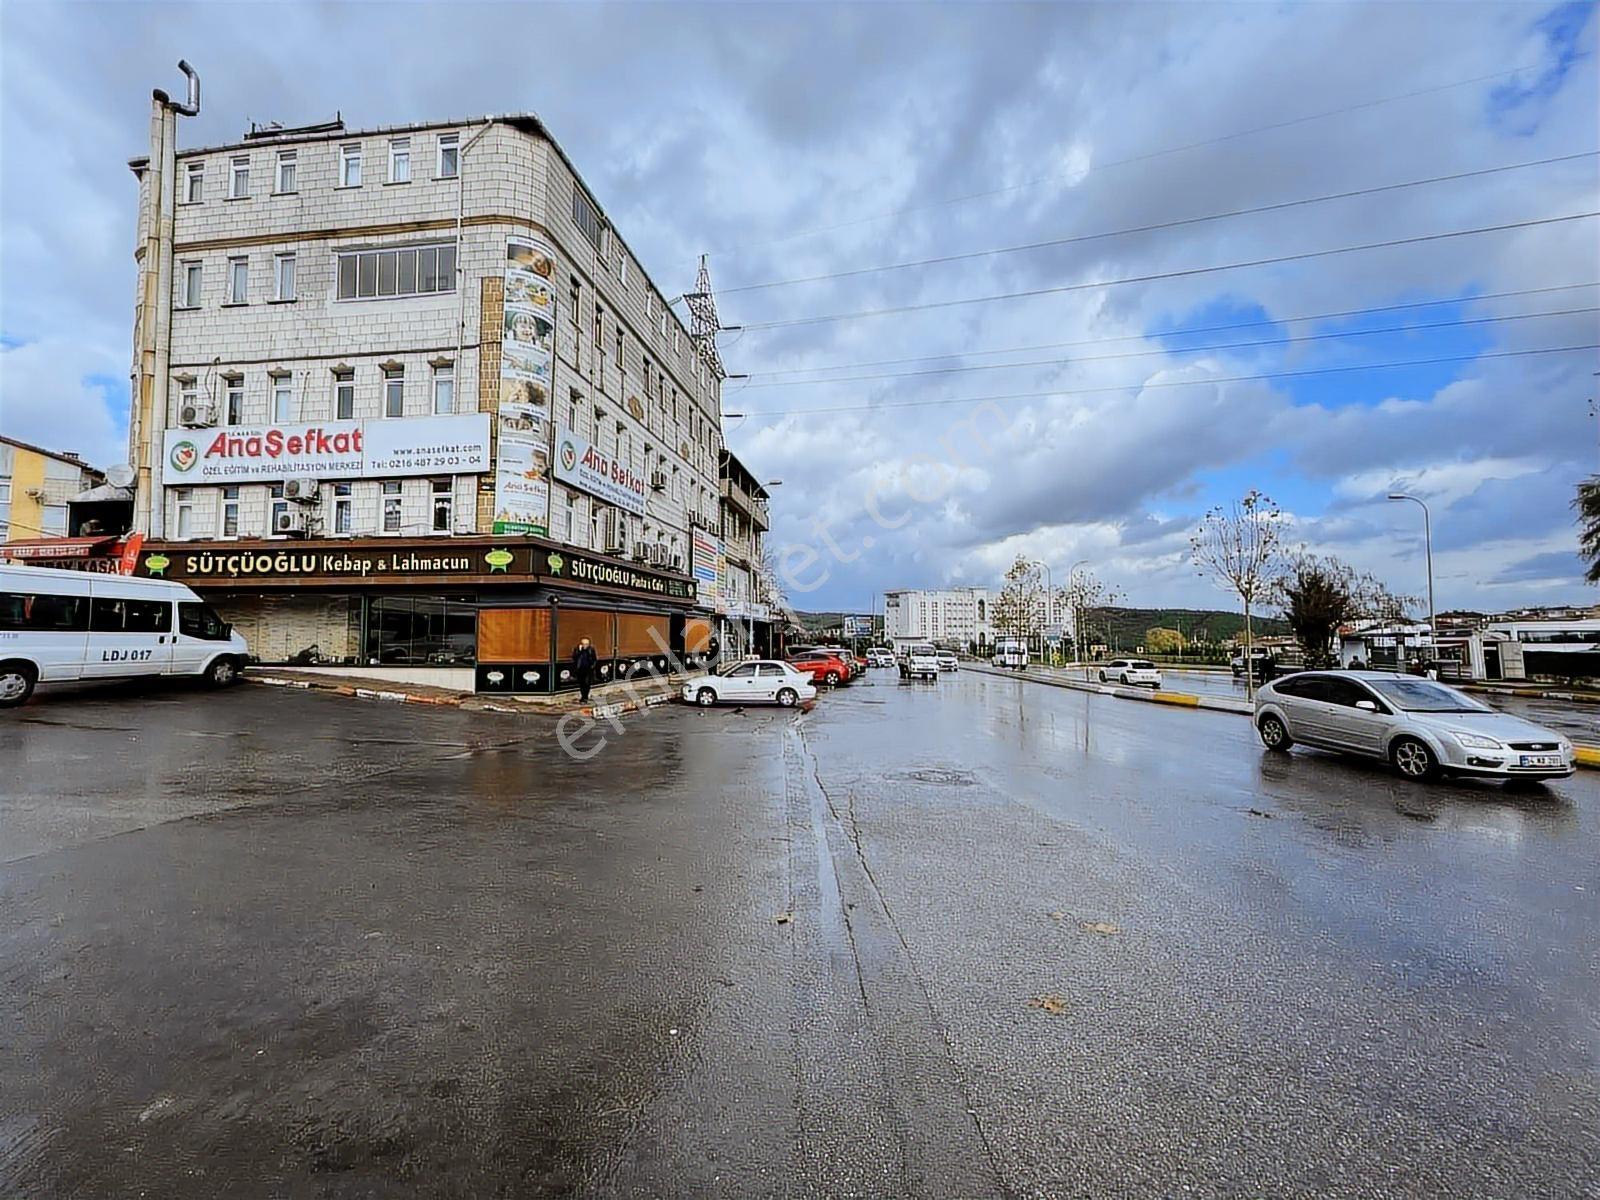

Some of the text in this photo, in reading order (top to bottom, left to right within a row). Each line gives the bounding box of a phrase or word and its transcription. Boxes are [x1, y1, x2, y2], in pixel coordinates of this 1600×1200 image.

[202, 464, 223, 476] ÖZEL
[580, 446, 608, 476] Ana
[78, 559, 124, 575] KASA
[187, 552, 469, 577] SÜTÇÜOĞLU Kebap & Lahmacun
[571, 559, 630, 584] SÜTÇÜOĞLU
[102, 649, 153, 662] LDJ 017
